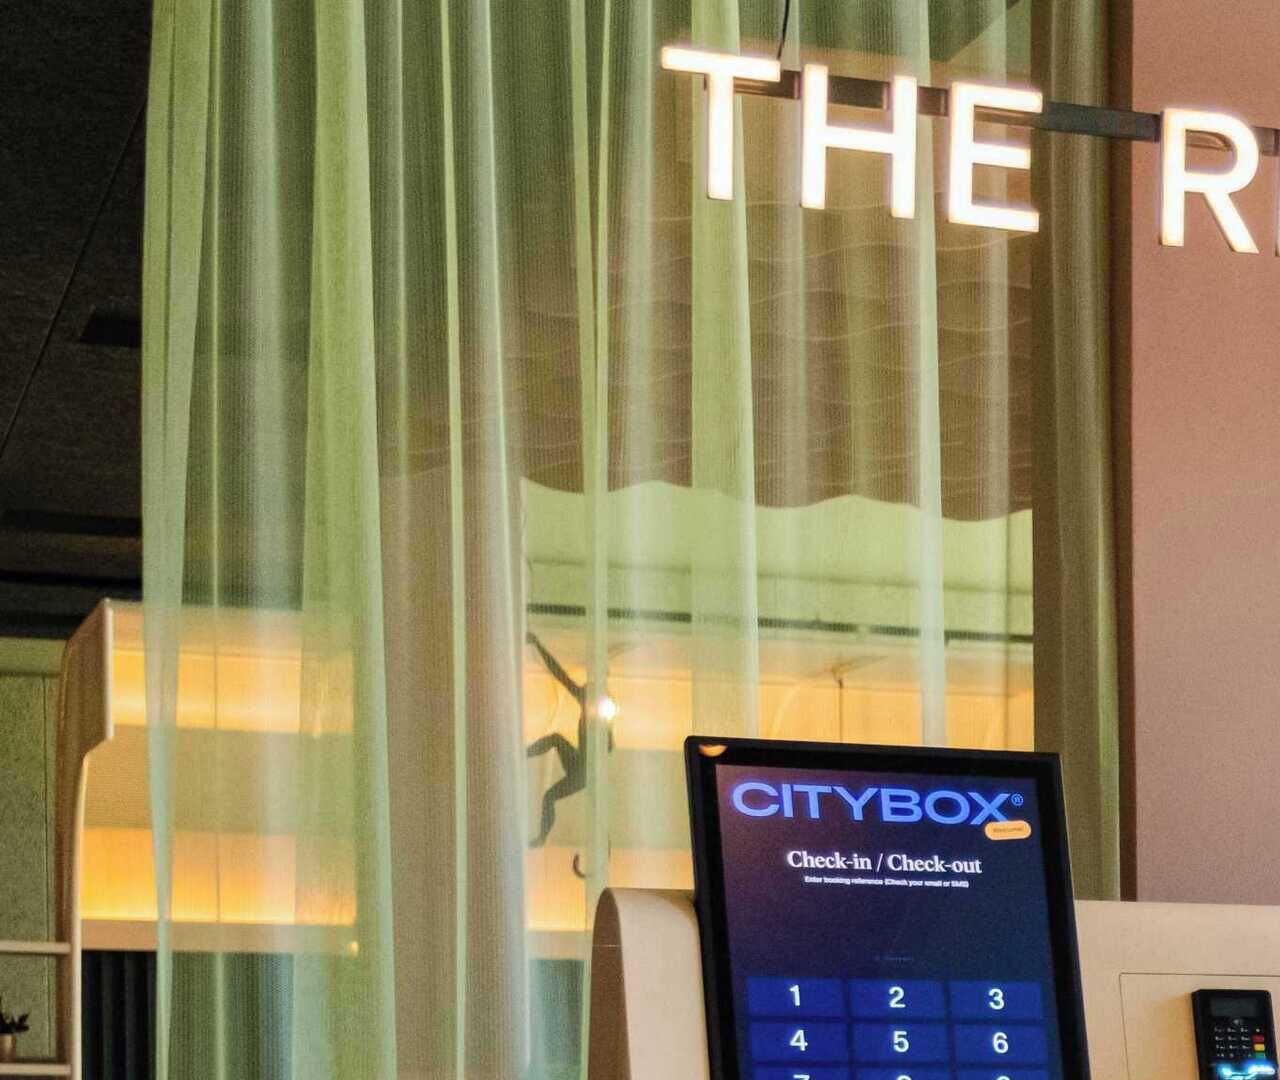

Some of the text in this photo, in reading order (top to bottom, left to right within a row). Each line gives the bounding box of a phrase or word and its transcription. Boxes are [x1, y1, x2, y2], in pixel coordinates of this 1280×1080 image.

[660, 46, 1043, 233] THE
[786, 849, 872, 871] Check-in
[887, 853, 983, 874] Check-out
[790, 984, 1005, 1010] 1 2 3
[790, 1029, 1009, 1054] 4 5 6
